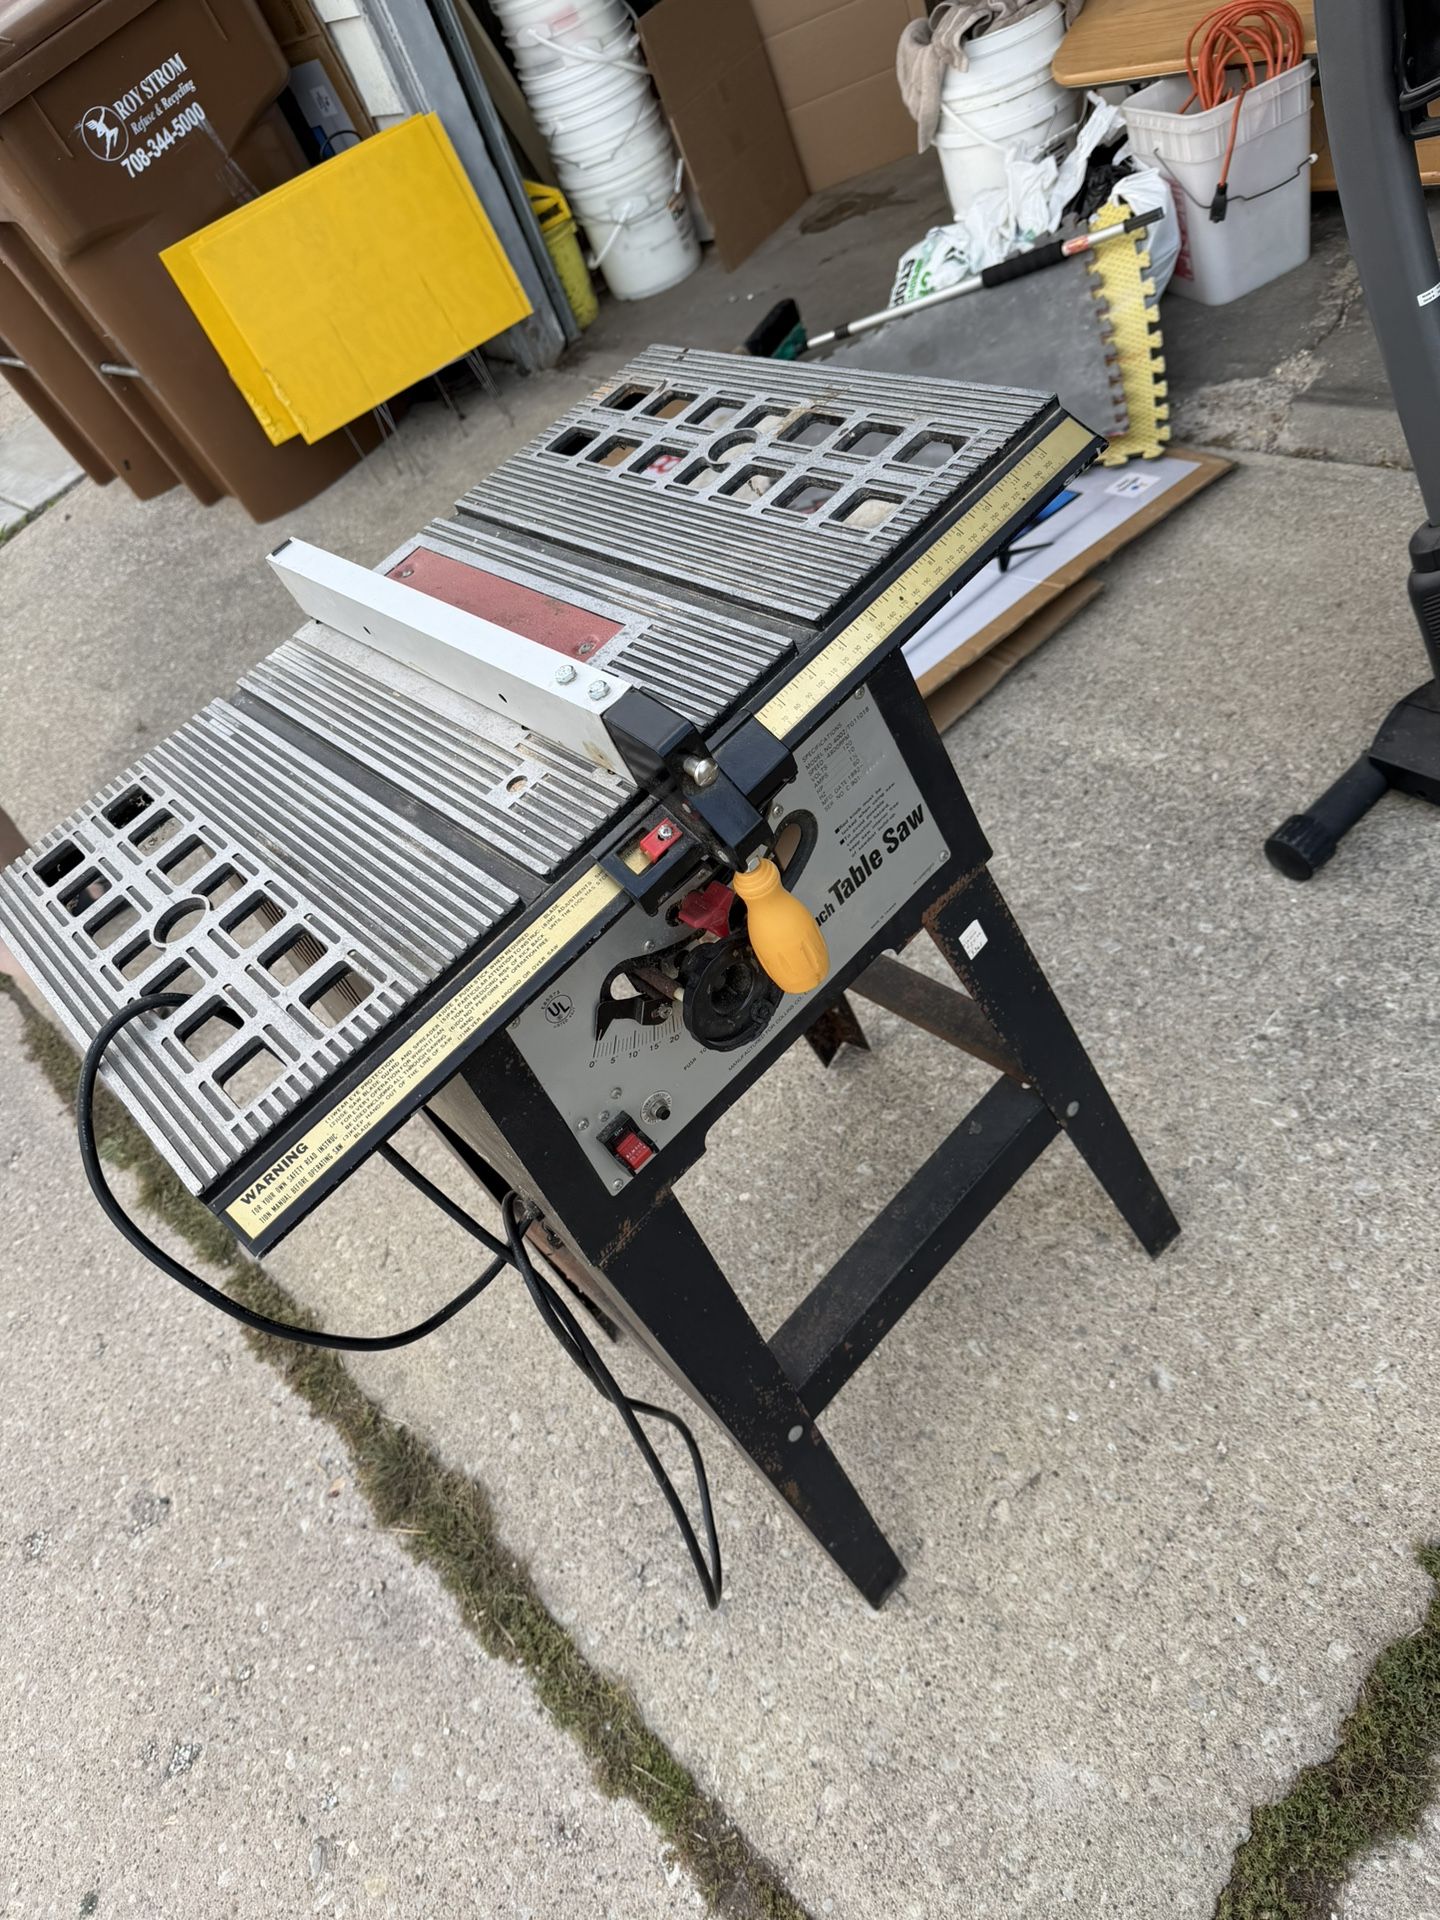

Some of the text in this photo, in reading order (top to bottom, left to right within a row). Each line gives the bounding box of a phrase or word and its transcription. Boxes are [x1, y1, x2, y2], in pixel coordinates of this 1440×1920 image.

[113, 53, 187, 120] ROY STROM
[131, 80, 196, 135] Refuse & Recycling
[121, 102, 205, 177] 708-344-5000
[828, 849, 883, 905] Table
[883, 804, 924, 853] Saw
[543, 904, 559, 919] BLADE
[548, 916, 562, 930] UNTIL
[561, 908, 571, 917] THE
[571, 896, 584, 909] TOOL
[584, 886, 595, 896] HAS
[557, 881, 592, 913] ADJUSTMENTS
[451, 934, 544, 1021] TION ON REDUCING RISK OF KICK BACK
[457, 978, 488, 1007] PARTICULAR
[488, 954, 513, 979] ATTENTION
[513, 947, 521, 955] TO
[458, 984, 473, 998] PUSH
[473, 970, 488, 984] STICK
[489, 955, 504, 970] WHEN
[504, 932, 529, 955] REQUIRED
[463, 1006, 475, 1018] NOT
[474, 984, 499, 1007] PERFORM
[499, 974, 509, 984] ANY
[510, 948, 537, 974] OPERATION
[482, 999, 500, 1016] REACH
[501, 979, 521, 999] AROUND
[522, 970, 530, 978] OR
[531, 956, 546, 970] OVER
[546, 944, 558, 955] SAW
[548, 1001, 569, 1017] UL
[340, 1113, 352, 1126] FOR
[351, 1097, 370, 1115] EVERY
[370, 1069, 400, 1098] OPERATION
[399, 1059, 411, 1070] FOR
[411, 1042, 428, 1059] WHICH
[432, 1028, 444, 1039] CAN
[344, 1034, 446, 1130] BE USED INCLUDING ALL THROUGH SAWING
[348, 1096, 361, 1109] SAW
[362, 1079, 380, 1097] BLADE
[380, 1061, 400, 1079] GUARD
[400, 1050, 412, 1061] AND
[412, 1023, 439, 1049] SPREADER
[348, 1090, 360, 1101] EYE
[360, 1058, 395, 1090] PROTECTION
[365, 1101, 384, 1119] HANDS
[385, 1088, 397, 1100] OUT
[398, 1080, 406, 1088] OF
[407, 1068, 418, 1079] THE
[419, 1056, 431, 1068] LINE
[431, 1048, 439, 1056] OF
[440, 1036, 452, 1048] SAW
[353, 1121, 371, 1138] BLADE
[240, 1143, 308, 1204] WARNING
[251, 1204, 262, 1216] FOR
[262, 1191, 276, 1205] YOUR
[275, 1181, 287, 1193] OWN
[286, 1164, 304, 1182] SAFETY
[304, 1152, 317, 1166] READ
[258, 1143, 343, 1224] TION MANUAL BEFORE OPERATING SAW
